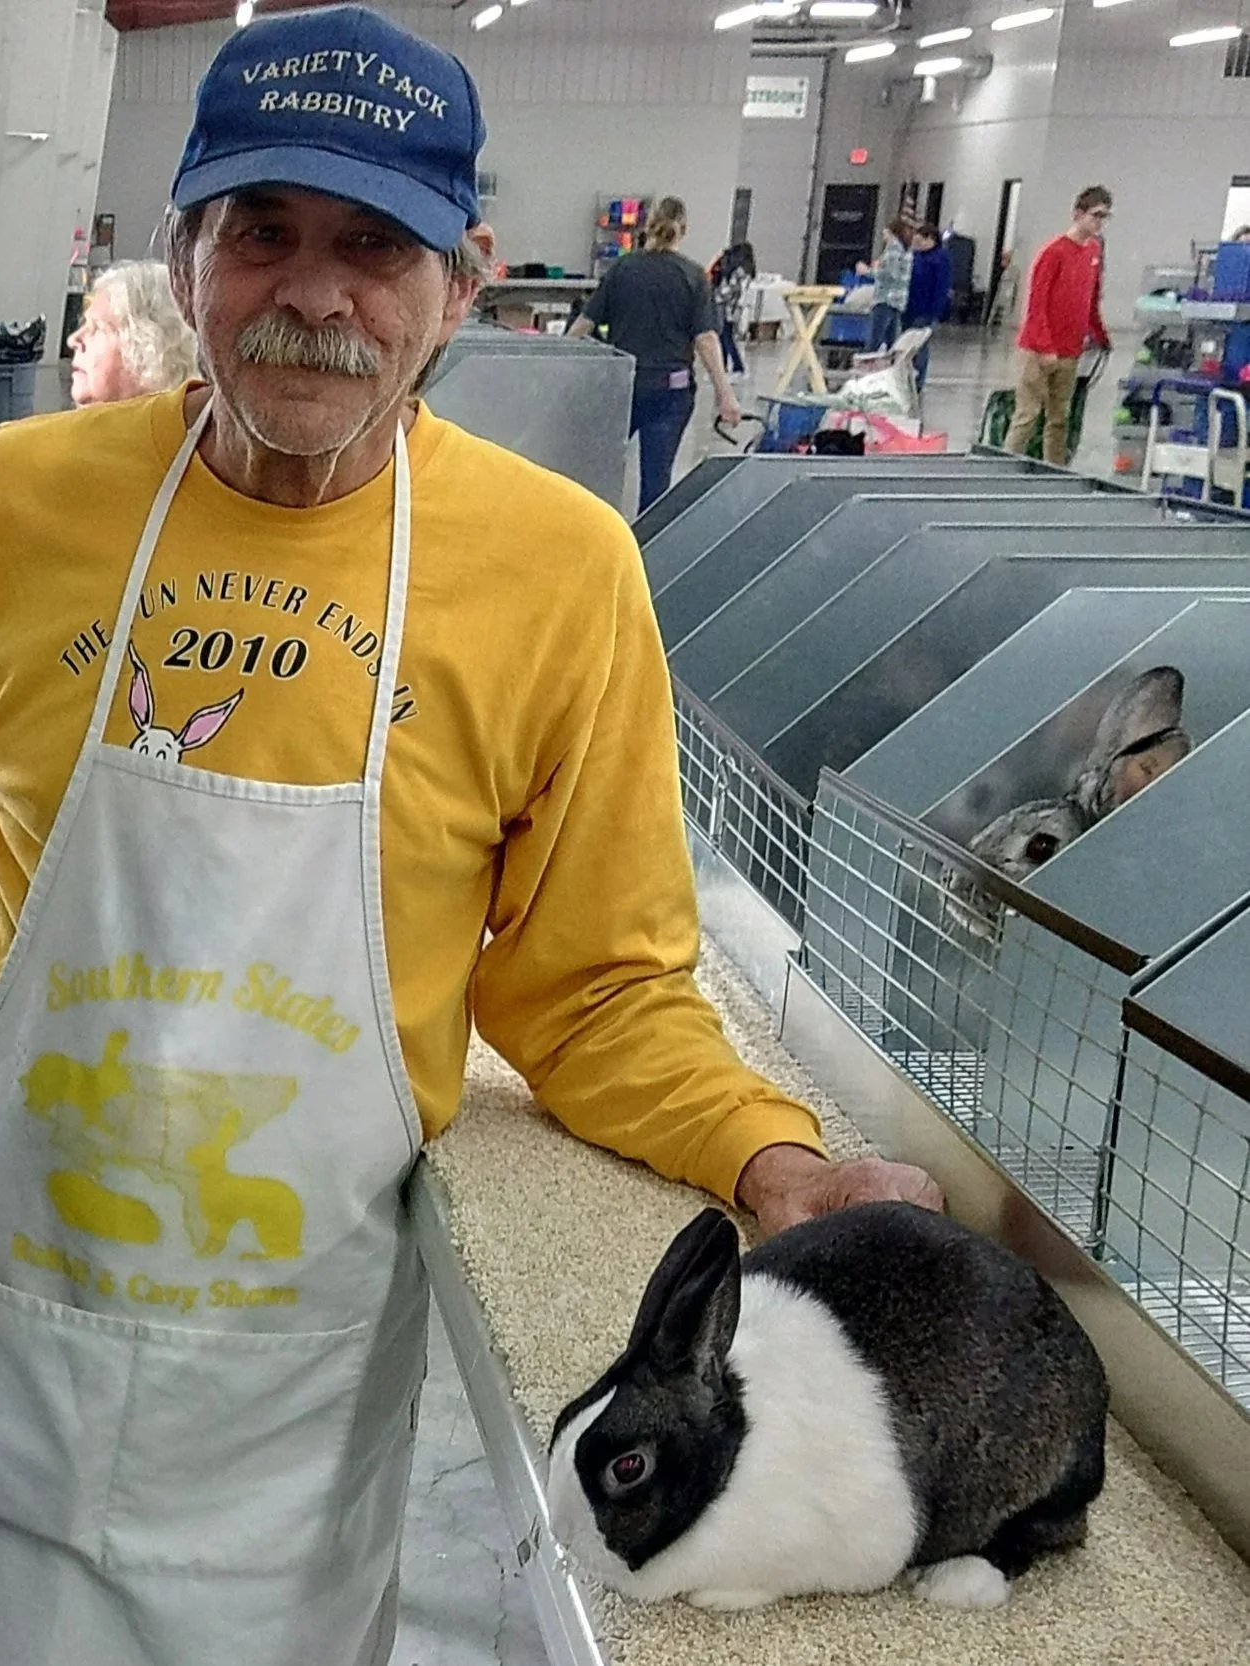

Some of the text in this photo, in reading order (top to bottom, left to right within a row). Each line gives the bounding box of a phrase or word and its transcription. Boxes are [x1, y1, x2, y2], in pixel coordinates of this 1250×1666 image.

[241, 49, 449, 120] VARIETY PACK
[258, 90, 416, 132] RABBITRY
[59, 618, 113, 676] THE
[134, 577, 177, 622] UN
[196, 571, 308, 615] NEVER
[390, 684, 419, 724] IN
[162, 627, 308, 679] 2010
[46, 952, 361, 1054] Southern States
